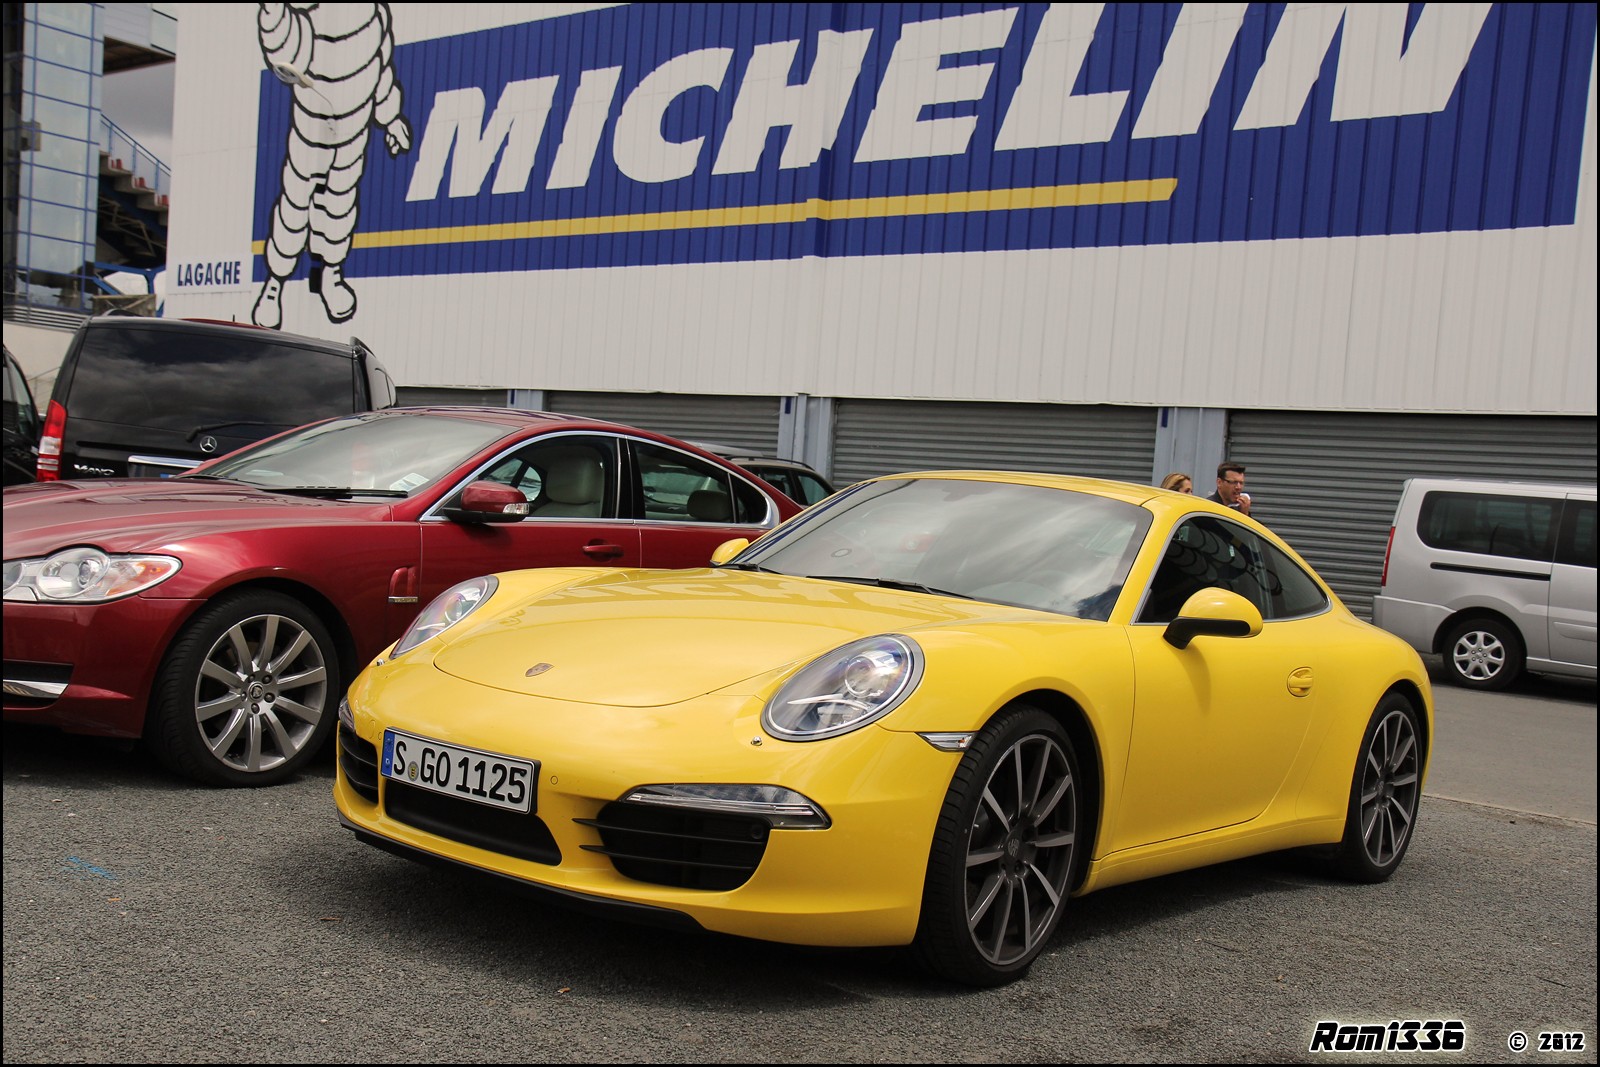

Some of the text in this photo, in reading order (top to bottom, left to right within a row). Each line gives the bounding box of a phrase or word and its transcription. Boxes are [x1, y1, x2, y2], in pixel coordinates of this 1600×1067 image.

[405, 3, 1493, 201] MICHELIN
[177, 261, 241, 286] LAGACHE
[393, 740, 528, 804] S GO 1125
